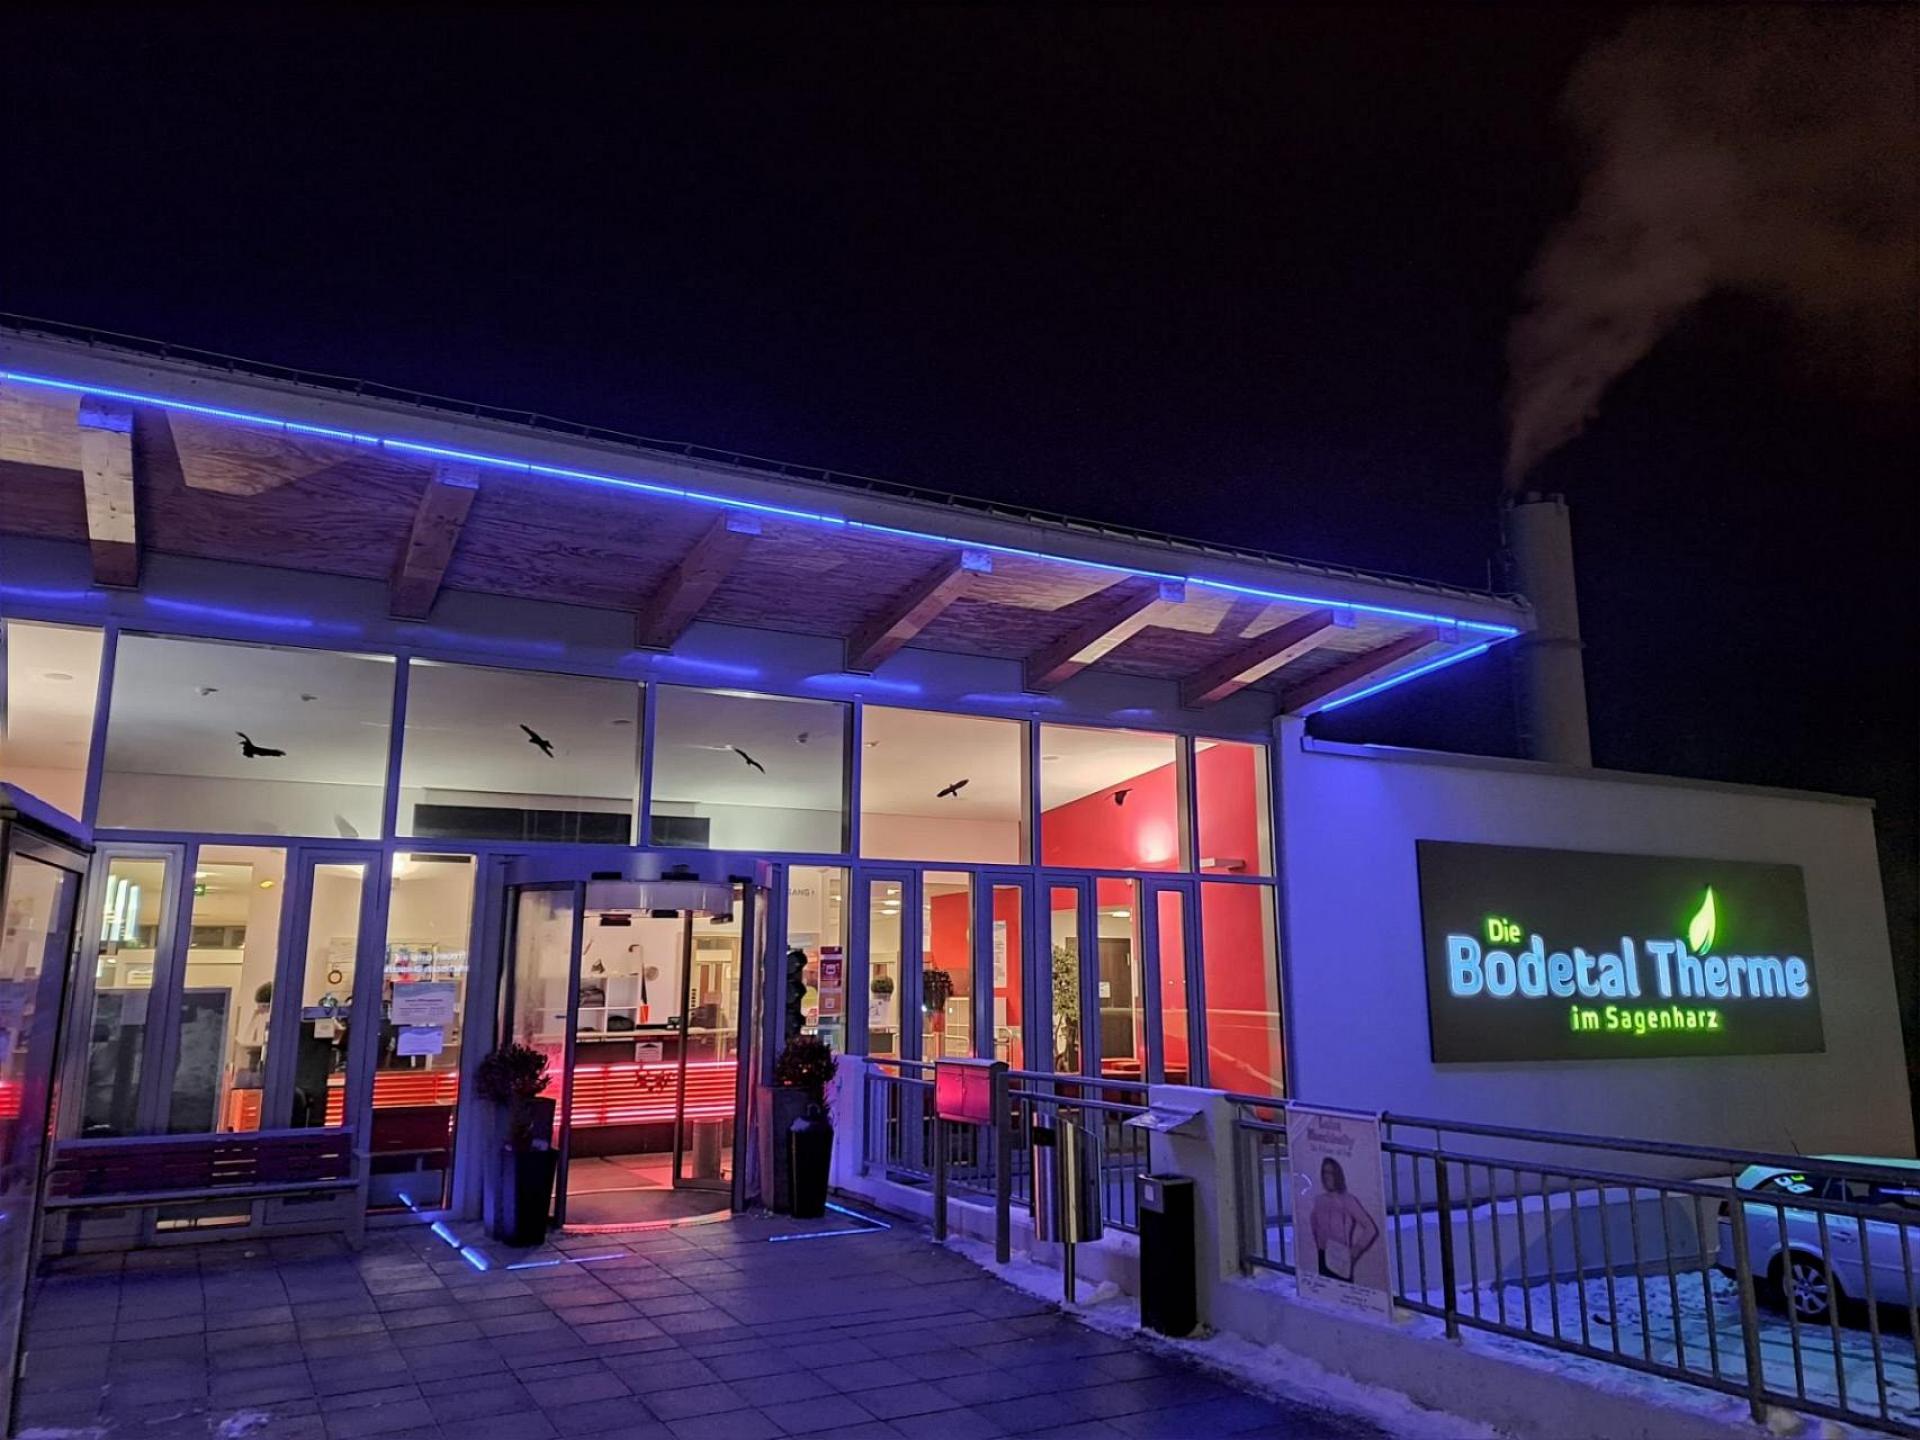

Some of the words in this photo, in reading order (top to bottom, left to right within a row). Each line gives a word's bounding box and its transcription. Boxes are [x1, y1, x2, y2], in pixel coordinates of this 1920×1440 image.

[1488, 918, 1521, 943] Die
[1446, 933, 1641, 999] Bodetal
[1646, 939, 1810, 999] Therme
[1571, 1006, 1600, 1031] im
[1606, 1006, 1720, 1036] Sagenharz
